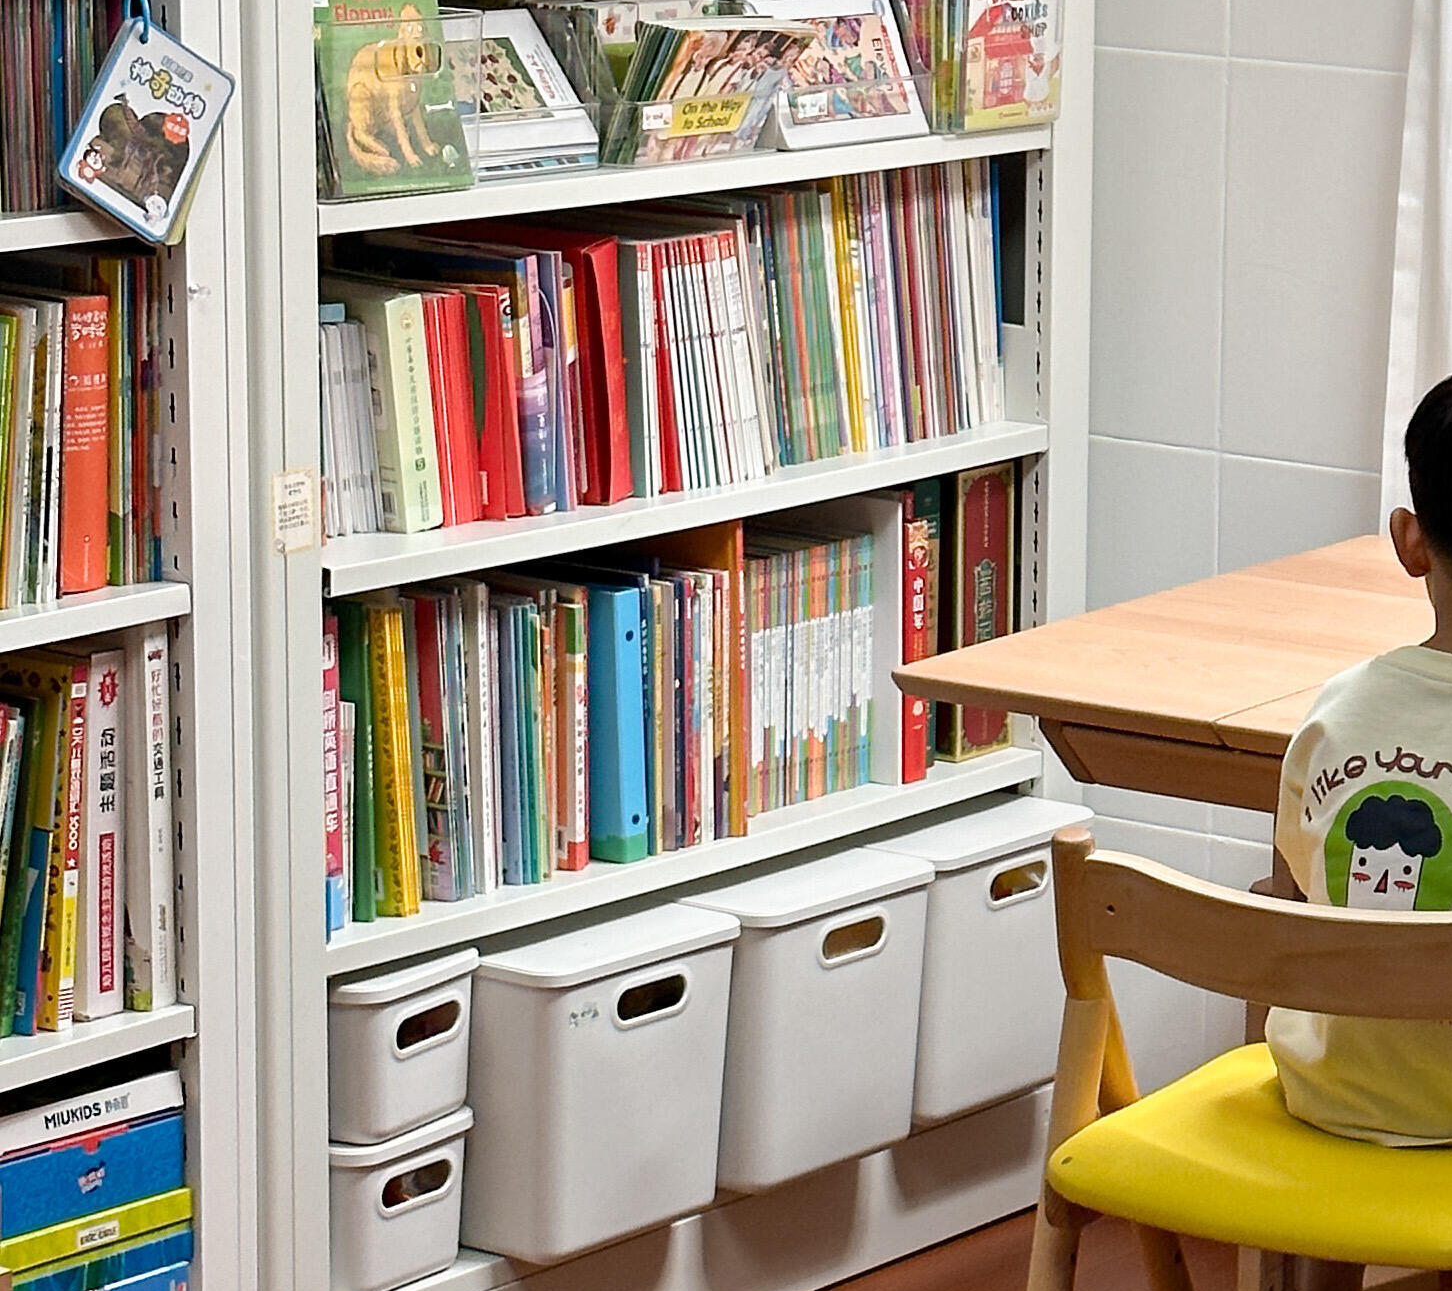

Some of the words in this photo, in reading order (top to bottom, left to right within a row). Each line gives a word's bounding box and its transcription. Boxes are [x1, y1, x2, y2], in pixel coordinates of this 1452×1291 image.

[682, 102, 698, 115] On
[700, 101, 718, 113] the
[696, 113, 732, 129] School
[99, 728, 116, 813] 主题活动
[1310, 755, 1367, 805] like
[43, 1102, 102, 1130] MIUKIDS
